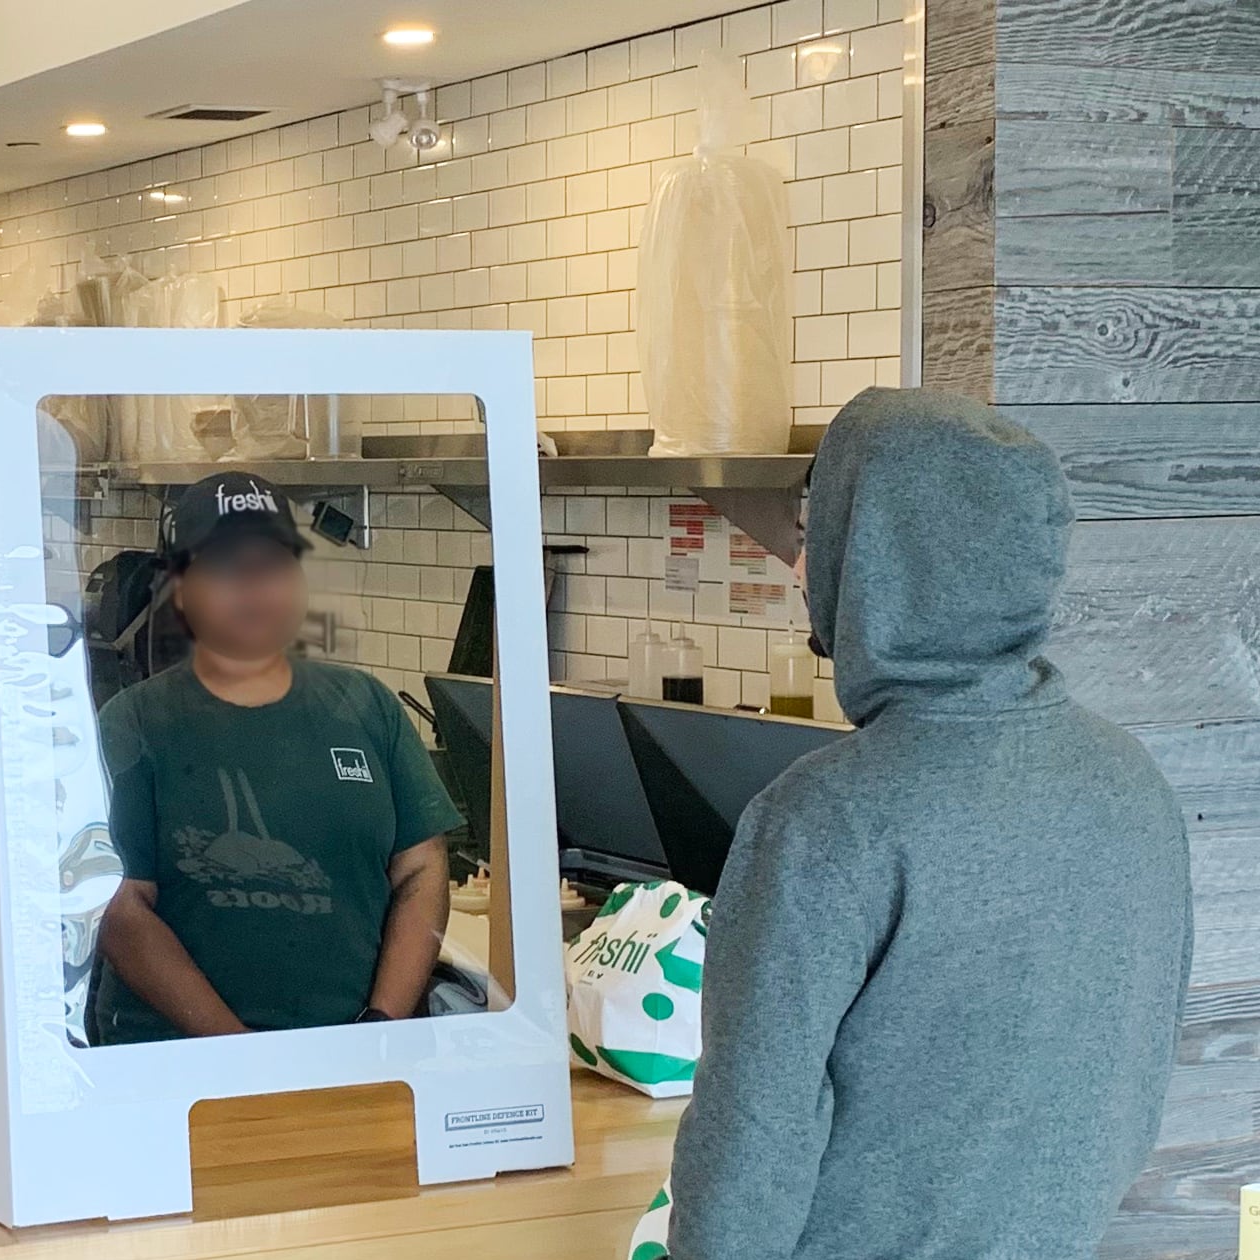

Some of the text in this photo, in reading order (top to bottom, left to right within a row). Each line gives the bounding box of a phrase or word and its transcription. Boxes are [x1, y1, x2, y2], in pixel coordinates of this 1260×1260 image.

[451, 1107, 539, 1125] FRONTLINE DEFENCE KIT
